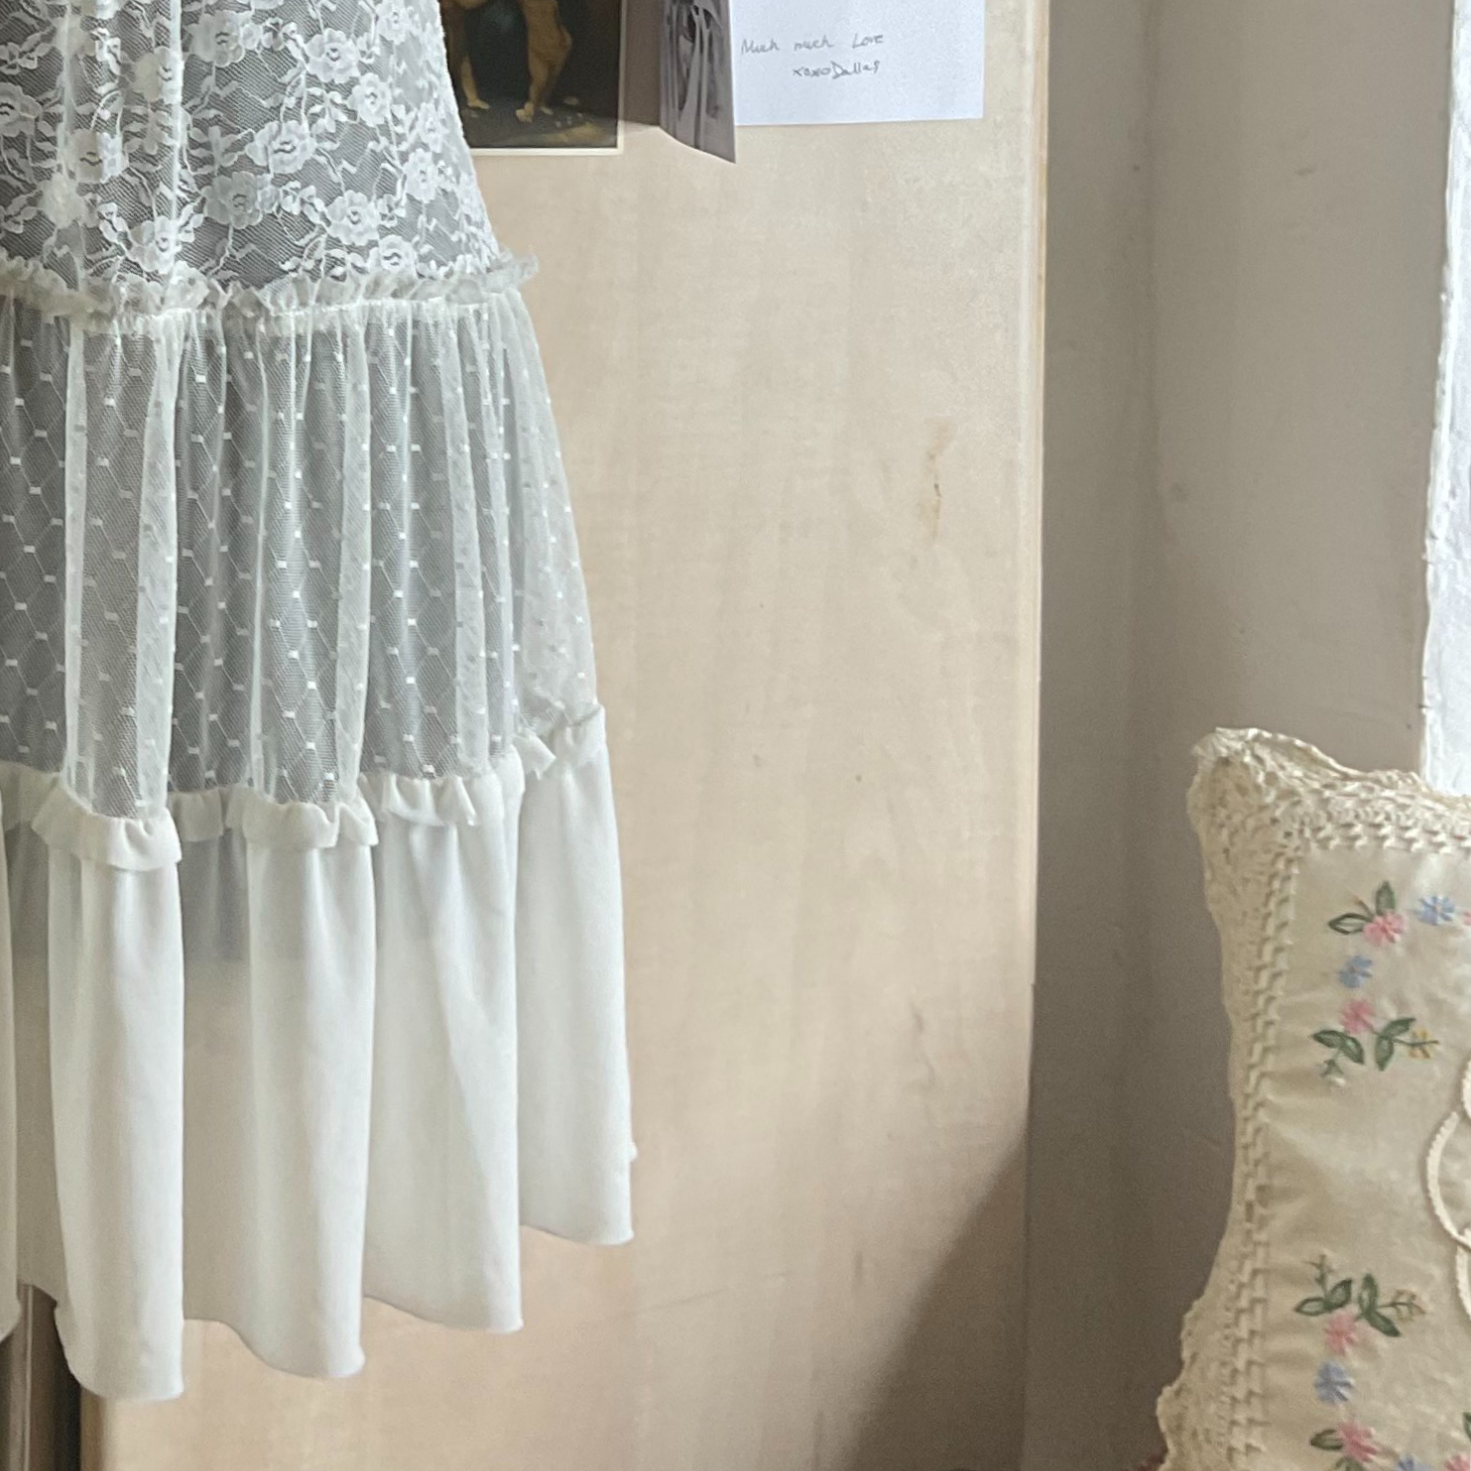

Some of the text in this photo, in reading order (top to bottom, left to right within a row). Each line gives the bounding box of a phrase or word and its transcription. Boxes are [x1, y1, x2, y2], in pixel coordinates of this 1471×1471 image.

[741, 32, 885, 55] Much much Love
